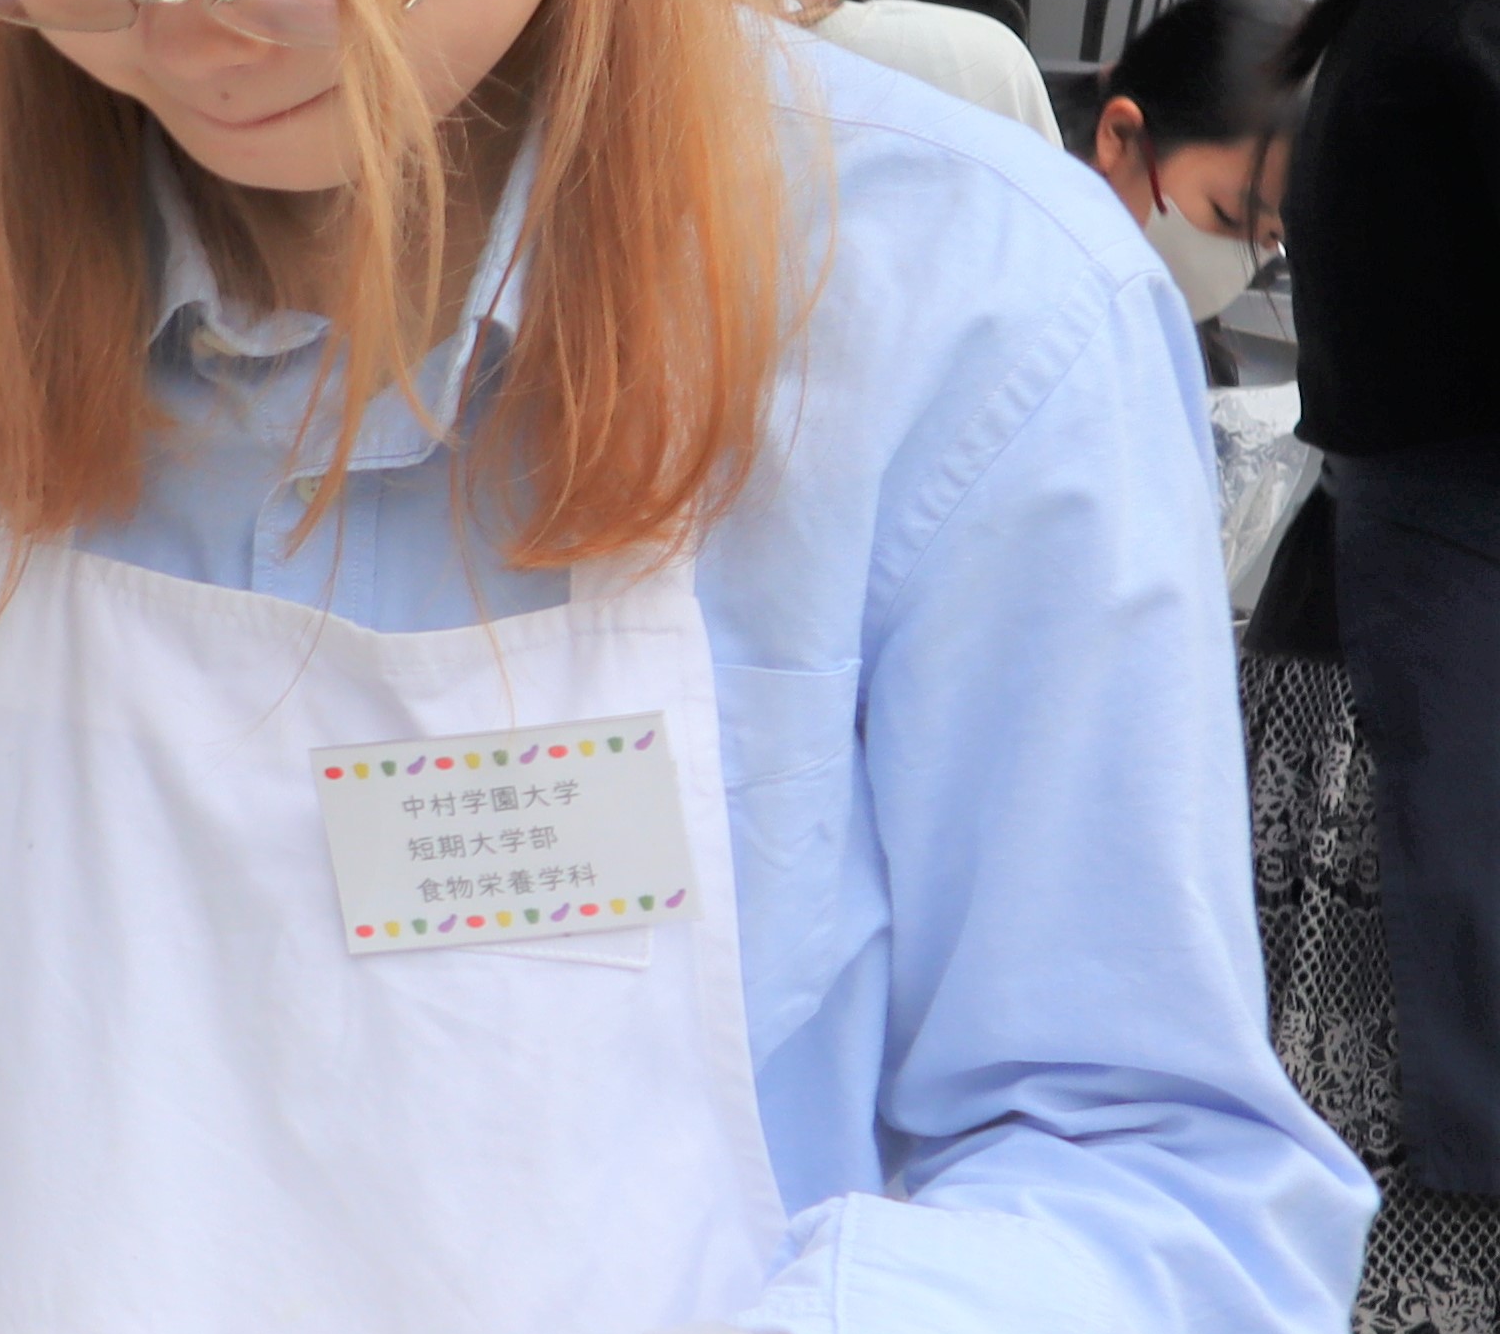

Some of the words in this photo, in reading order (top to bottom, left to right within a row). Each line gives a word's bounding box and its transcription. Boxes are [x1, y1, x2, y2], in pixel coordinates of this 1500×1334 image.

[402, 780, 580, 820] 中村学園大学
[408, 825, 558, 861] 短期大学部
[417, 863, 597, 903] 食物栄養学科
